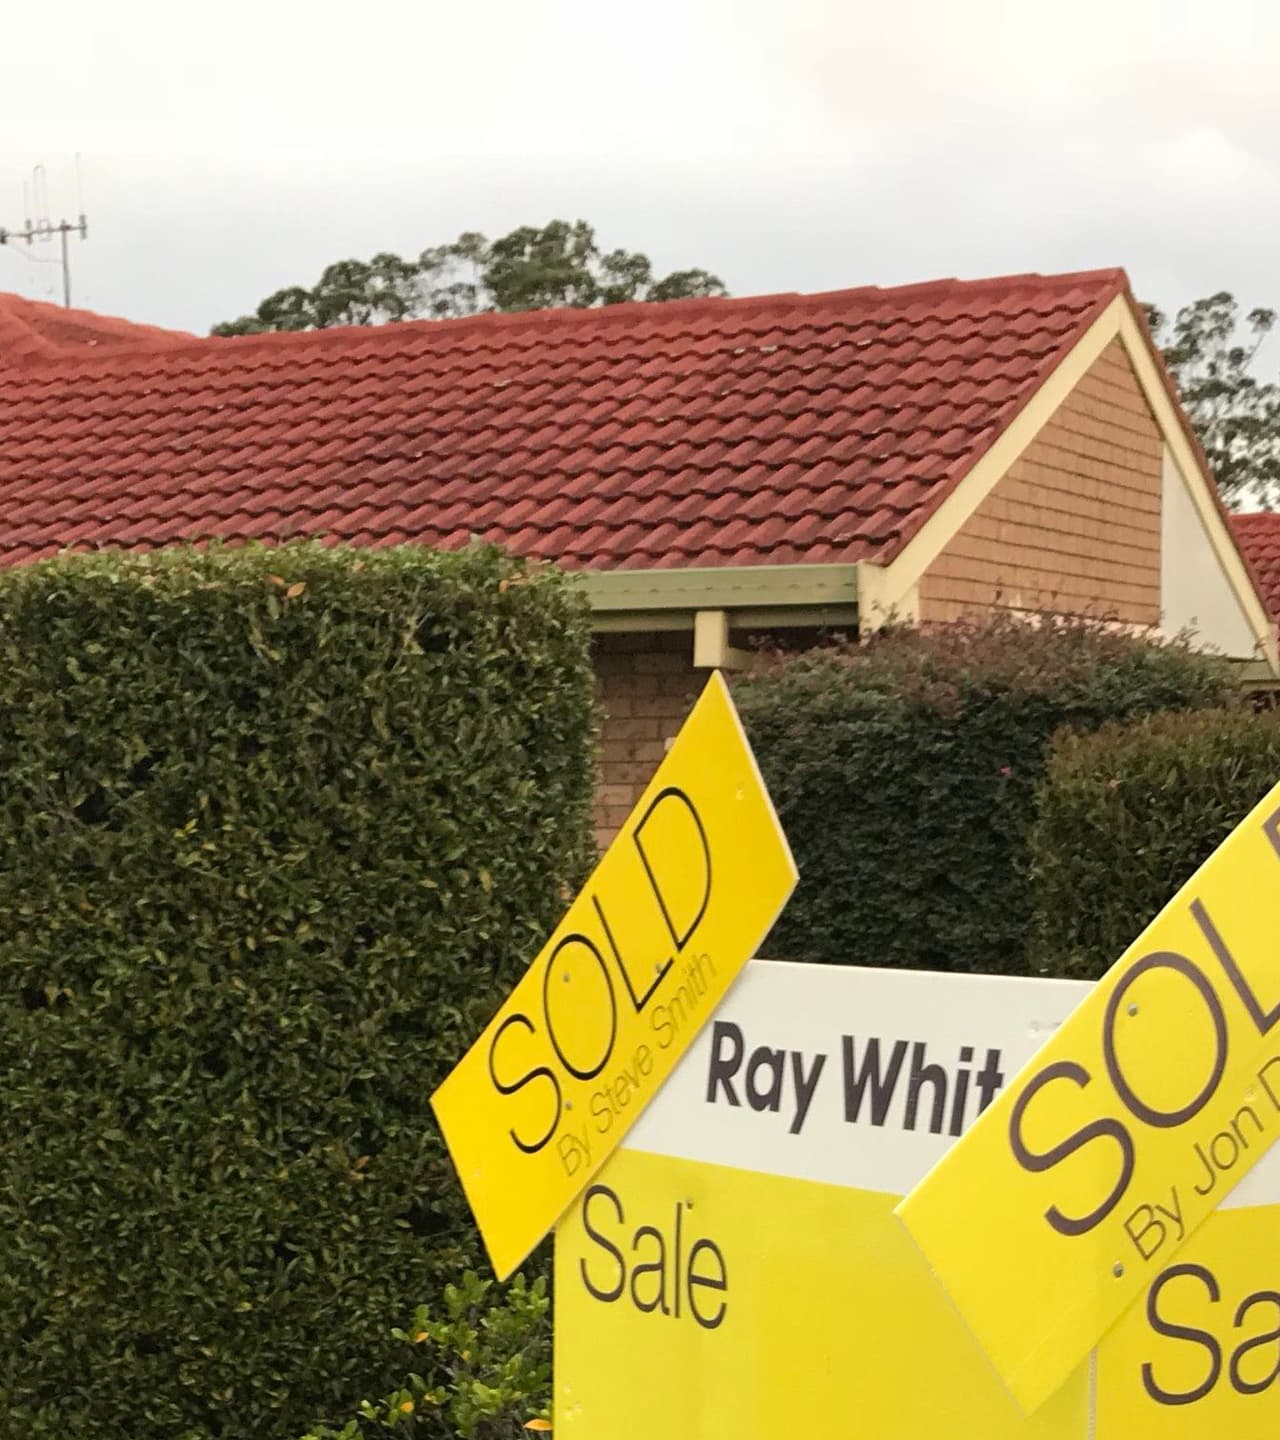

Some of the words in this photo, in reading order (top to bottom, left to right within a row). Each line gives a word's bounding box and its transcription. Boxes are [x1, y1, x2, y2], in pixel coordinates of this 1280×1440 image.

[489, 787, 711, 1153] SOLD
[557, 1124, 592, 1176] By
[590, 1044, 653, 1133] Steve
[651, 953, 717, 1049] Smith
[706, 1021, 825, 1135] Ray
[842, 1035, 1004, 1137] Whit
[580, 1184, 728, 1329] Sale
[1125, 1184, 1186, 1262] By
[1193, 1106, 1261, 1196] Jon
